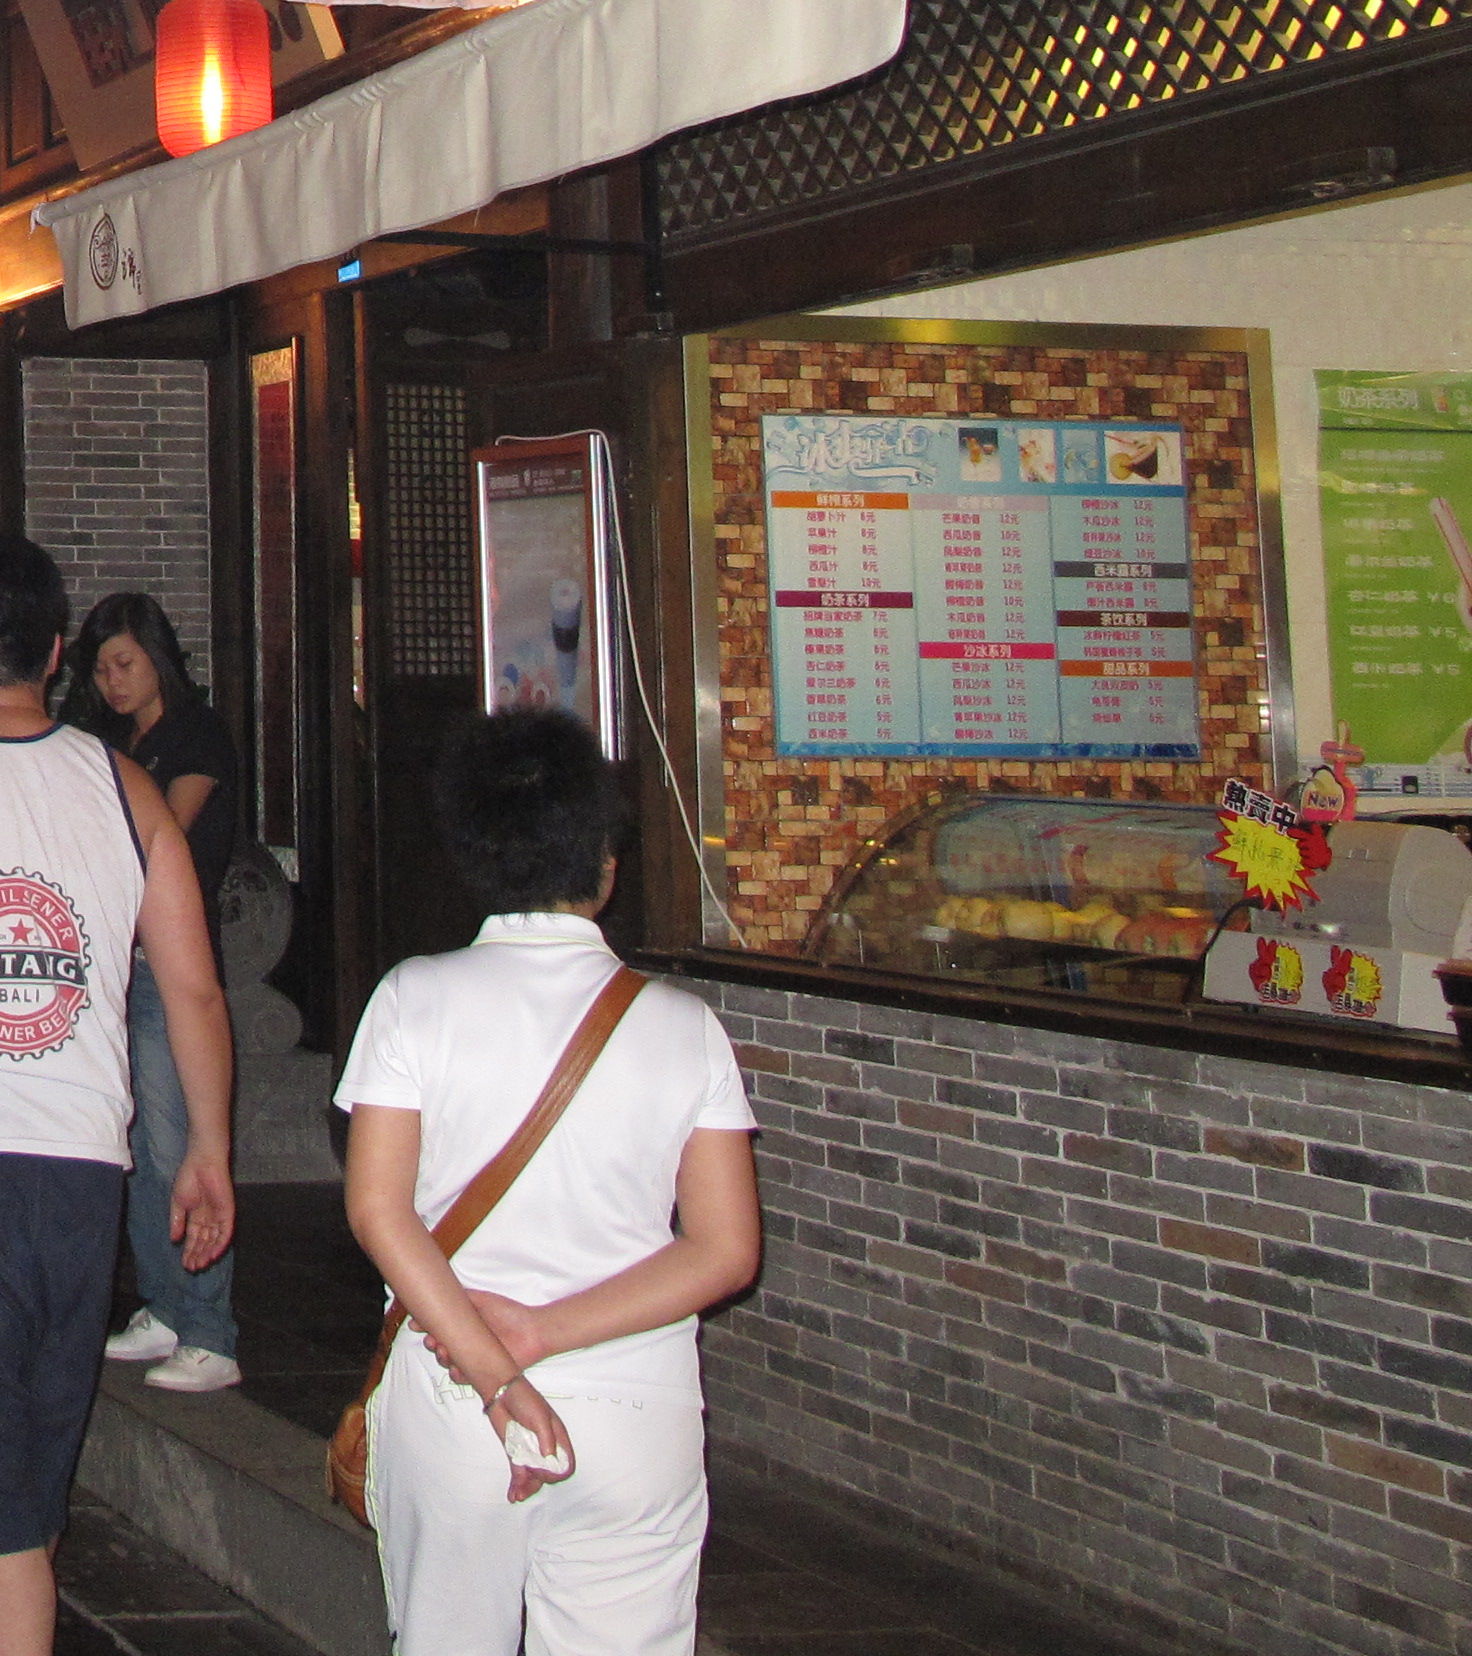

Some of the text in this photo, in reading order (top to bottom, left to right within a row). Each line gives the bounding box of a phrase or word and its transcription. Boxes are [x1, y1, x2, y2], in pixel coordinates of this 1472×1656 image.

[820, 593, 869, 607] 奶茶系列
[964, 645, 1011, 658] 沙冰系列
